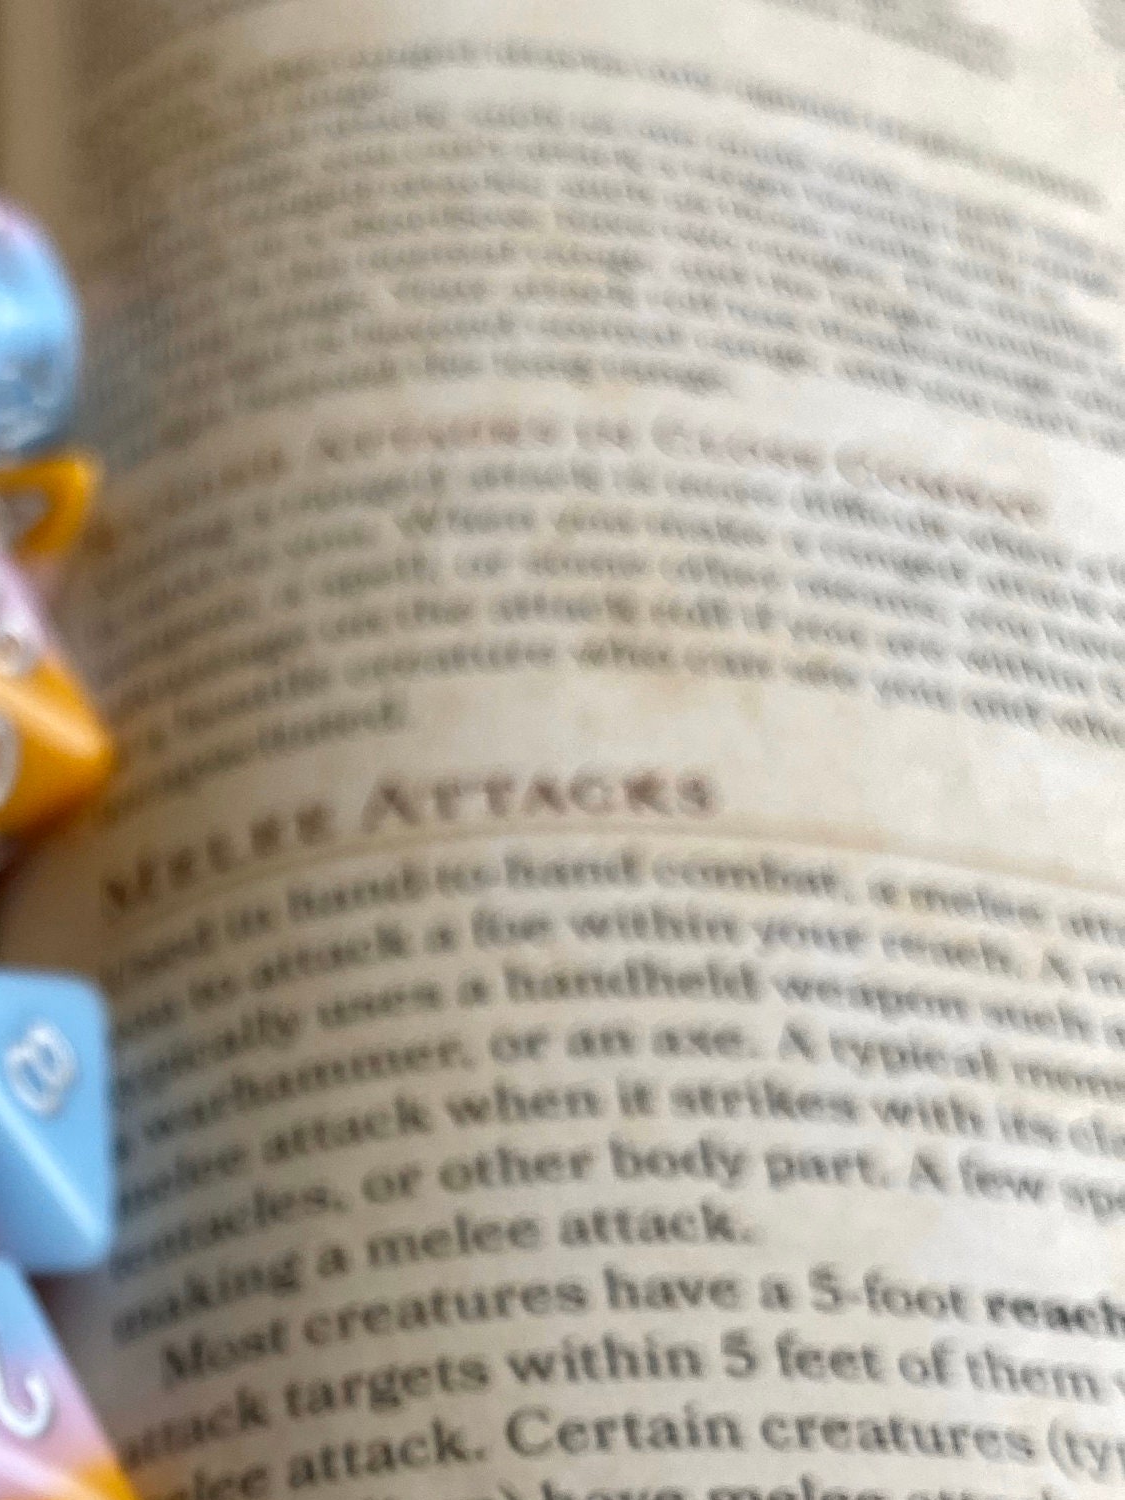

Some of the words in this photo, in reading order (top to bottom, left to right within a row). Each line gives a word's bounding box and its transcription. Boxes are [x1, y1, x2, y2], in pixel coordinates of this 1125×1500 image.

[445, 1082, 603, 1130] when
[361, 1161, 421, 1204] or
[438, 1147, 595, 1192] other
[609, 1136, 745, 1188] body
[366, 1212, 541, 1268] melee
[560, 1198, 758, 1248] attack.
[303, 1277, 589, 1347] creatures
[603, 1265, 740, 1312] have
[285, 1351, 491, 1415] targets
[507, 1331, 706, 1387] within
[720, 1328, 756, 1380] 5
[776, 1327, 884, 1383] feet
[897, 1336, 955, 1384] of
[966, 1347, 1101, 1402] them
[288, 1416, 487, 1491] attack.
[505, 1404, 745, 1458] Certain
[760, 1413, 1037, 1460] creatures
